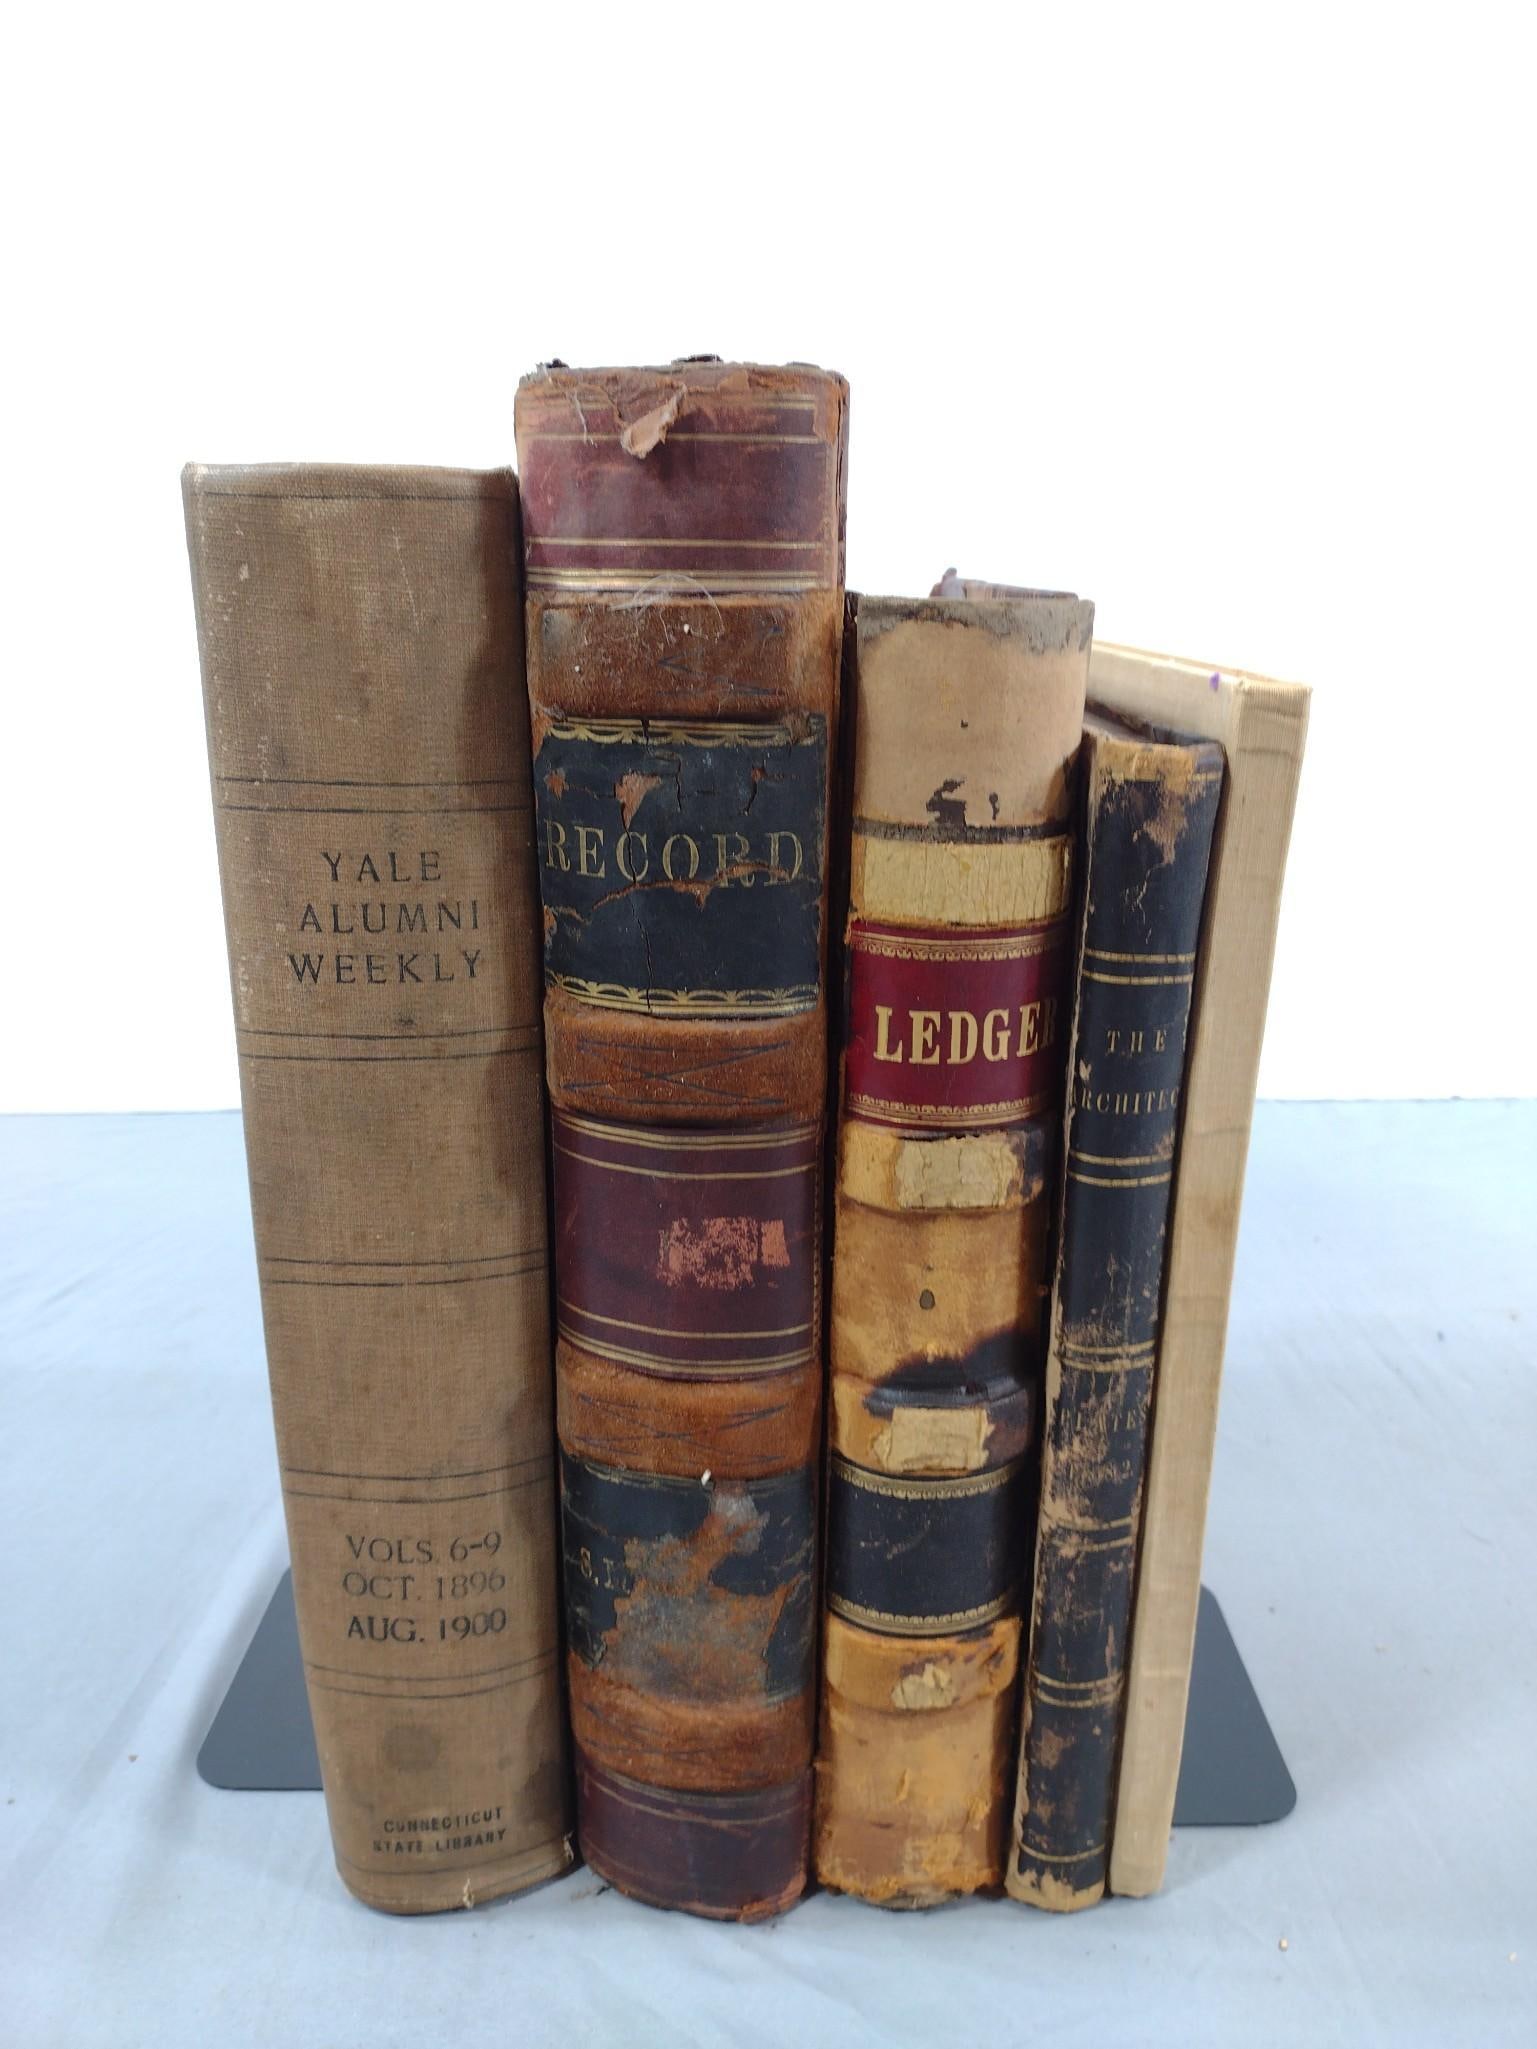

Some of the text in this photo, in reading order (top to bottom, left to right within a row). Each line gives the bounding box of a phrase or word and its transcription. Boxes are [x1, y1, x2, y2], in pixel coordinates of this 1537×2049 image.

[320, 851, 442, 882] YALE
[545, 819, 803, 889] RECORD
[299, 900, 480, 934] ALUMNI
[287, 949, 482, 984] WEEKLY
[1106, 1029, 1167, 1053] THE
[449, 1531, 502, 1562] 6-9
[342, 1567, 506, 1601] OCT. 1896
[347, 1608, 507, 1643] AUG. 1900
[383, 1806, 503, 1833] CONNECTICUT
[373, 1827, 506, 1853] STATE LIBRARY
